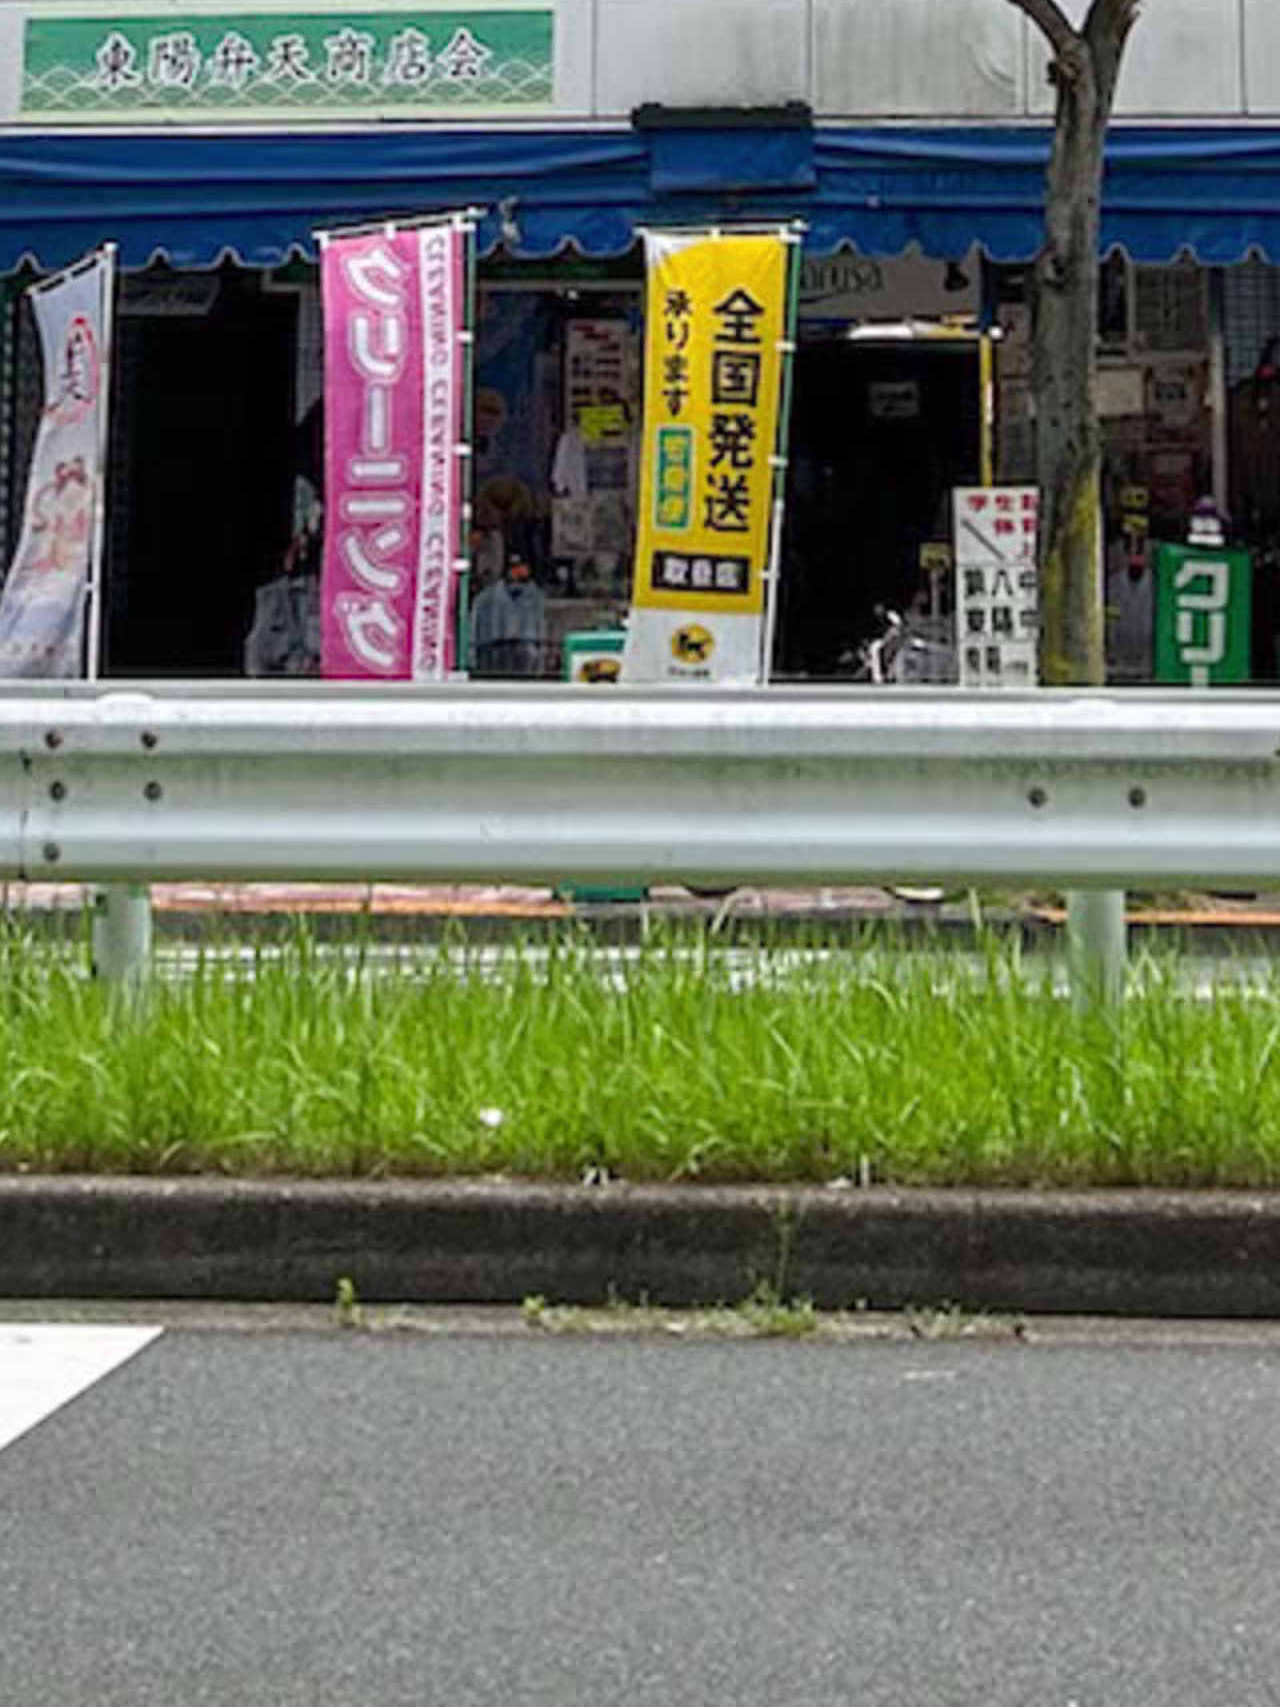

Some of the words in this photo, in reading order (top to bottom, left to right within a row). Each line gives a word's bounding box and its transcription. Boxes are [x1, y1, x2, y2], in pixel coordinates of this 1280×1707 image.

[96, 25, 492, 87] 東陽弁天商店会
[662, 290, 691, 416] 承ります
[704, 289, 764, 533] 全国発送
